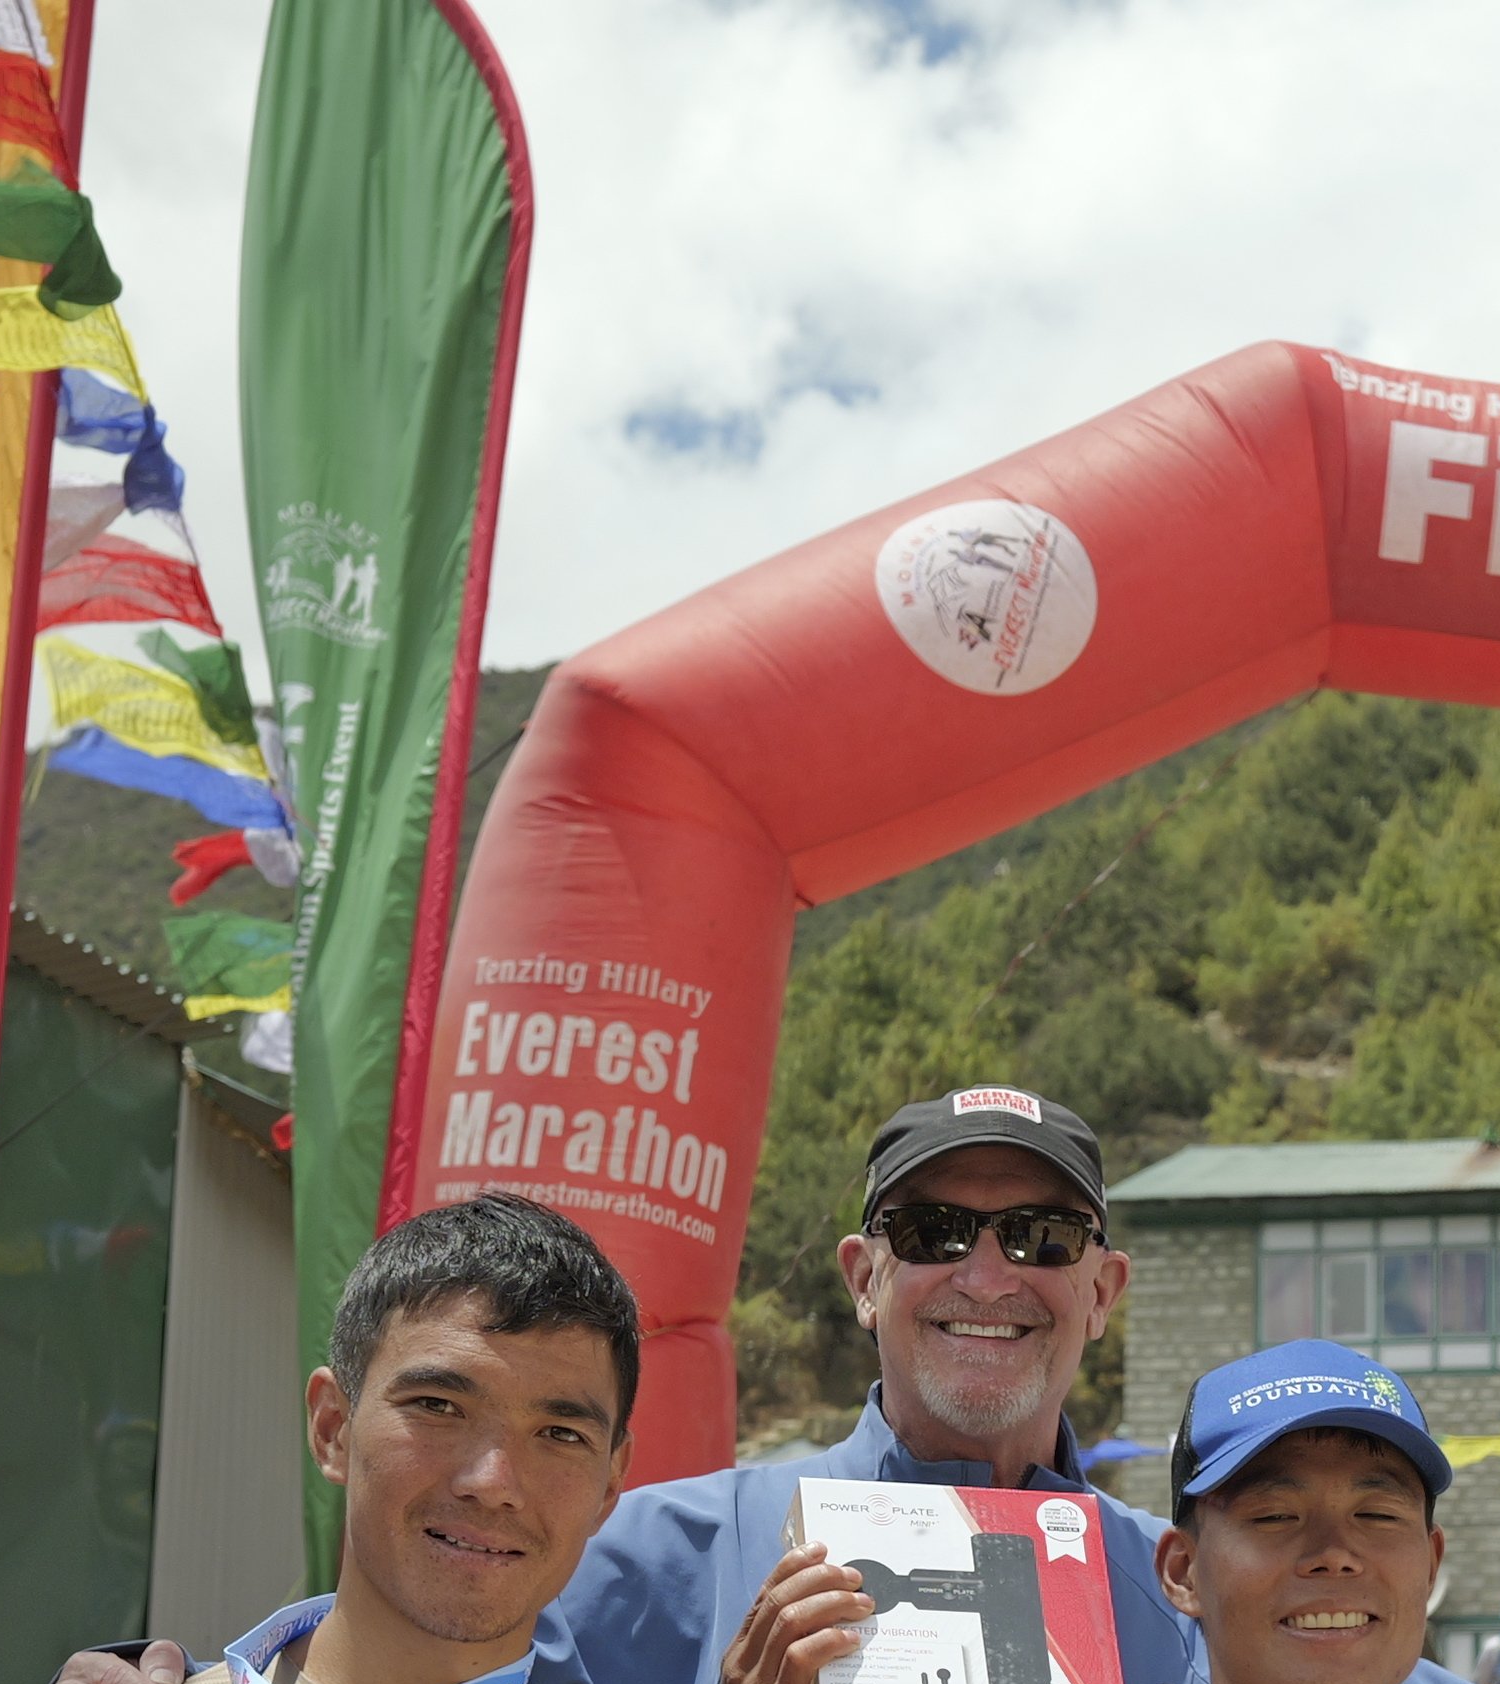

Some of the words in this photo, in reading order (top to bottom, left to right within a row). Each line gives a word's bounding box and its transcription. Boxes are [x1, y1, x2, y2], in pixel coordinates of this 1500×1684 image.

[1321, 353, 1474, 422] Tenzing
[322, 700, 361, 784] Event
[301, 788, 348, 890] Sports
[474, 953, 588, 993] Tenzing
[599, 960, 713, 1018] Hillary
[455, 1001, 700, 1104] Everest
[439, 1089, 728, 1213] Marathon
[1228, 1393, 1242, 1405] DR
[1242, 1380, 1274, 1399] SIGRID
[1274, 1375, 1368, 1390] SCHWARZENBACHER
[1230, 1381, 1402, 1417] FOUNDATION
[820, 1503, 869, 1513] POWER
[881, 1629, 938, 1638] VIBRATION
